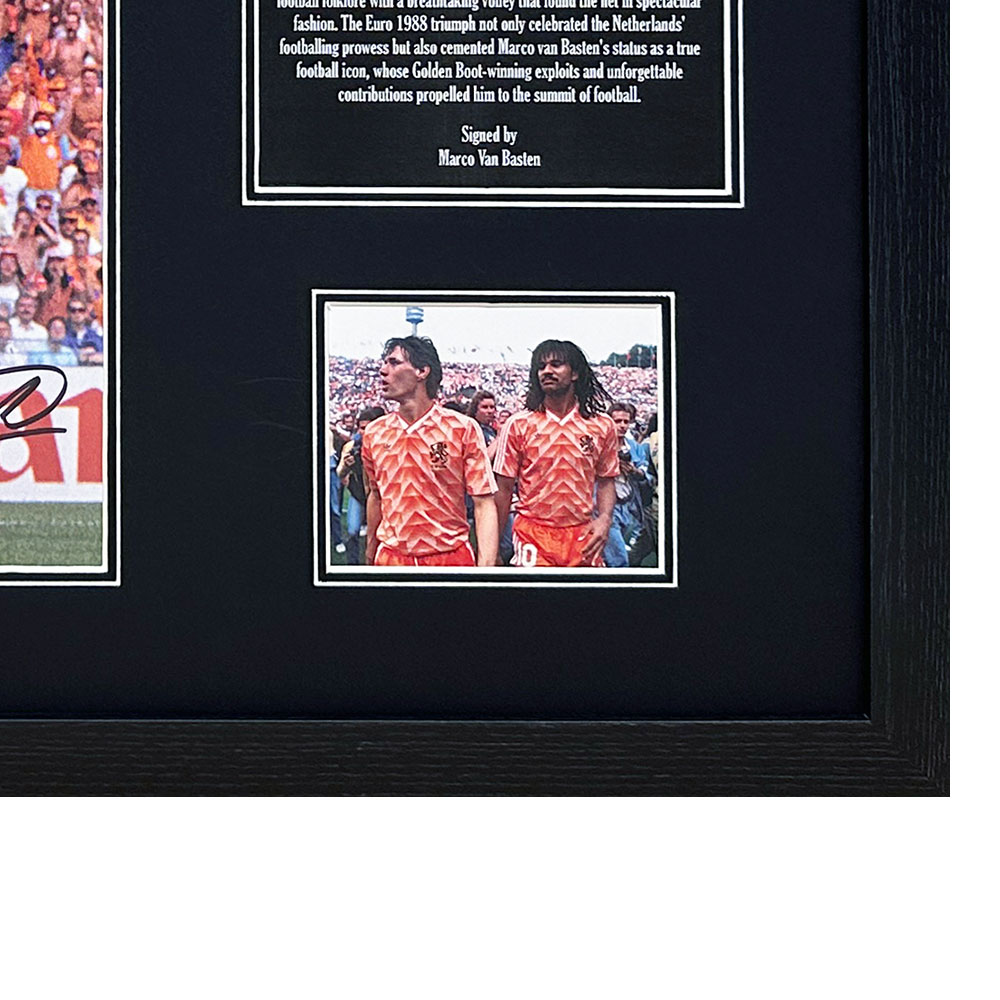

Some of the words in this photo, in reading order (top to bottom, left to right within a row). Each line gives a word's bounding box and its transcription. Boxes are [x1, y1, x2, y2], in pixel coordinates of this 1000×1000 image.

[292, 14, 339, 31] fashion.
[339, 14, 364, 31] The
[365, 14, 394, 31] Euro
[396, 15, 429, 31] 1988
[430, 14, 477, 34] triumph
[478, 17, 499, 31] not
[500, 15, 527, 34] only
[528, 14, 589, 31] celebrated
[590, 14, 611, 31] the
[611, 15, 686, 32] Netherlands'
[279, 38, 340, 57] footballing
[341, 44, 390, 57] prowess
[391, 38, 411, 55] but
[413, 38, 438, 55] also
[440, 38, 495, 55] cemented
[497, 38, 535, 55] Marco
[537, 44, 559, 55] van
[560, 38, 610, 55] Basten's
[612, 41, 648, 55] status
[649, 44, 664, 55] as
[666, 45, 674, 55] a
[676, 41, 701, 55] true
[295, 61, 340, 78] football
[341, 62, 371, 80] icon,
[372, 61, 410, 78] whose
[411, 61, 453, 78] Golden
[455, 62, 533, 81] Boot-winning
[534, 61, 581, 81] exploits
[582, 62, 605, 79] and
[606, 62, 684, 82] unforgettable
[337, 85, 414, 102] contributions
[415, 85, 471, 105] propelled
[473, 85, 496, 102] him
[497, 88, 510, 102] to
[512, 85, 532, 102] the
[533, 86, 577, 102] summit
[578, 85, 593, 102] of
[593, 85, 642, 102] football.
[460, 125, 501, 145] Signed
[502, 126, 519, 145] by
[438, 149, 476, 166] Marco
[477, 149, 500, 166] Van
[501, 149, 542, 166] Basten
